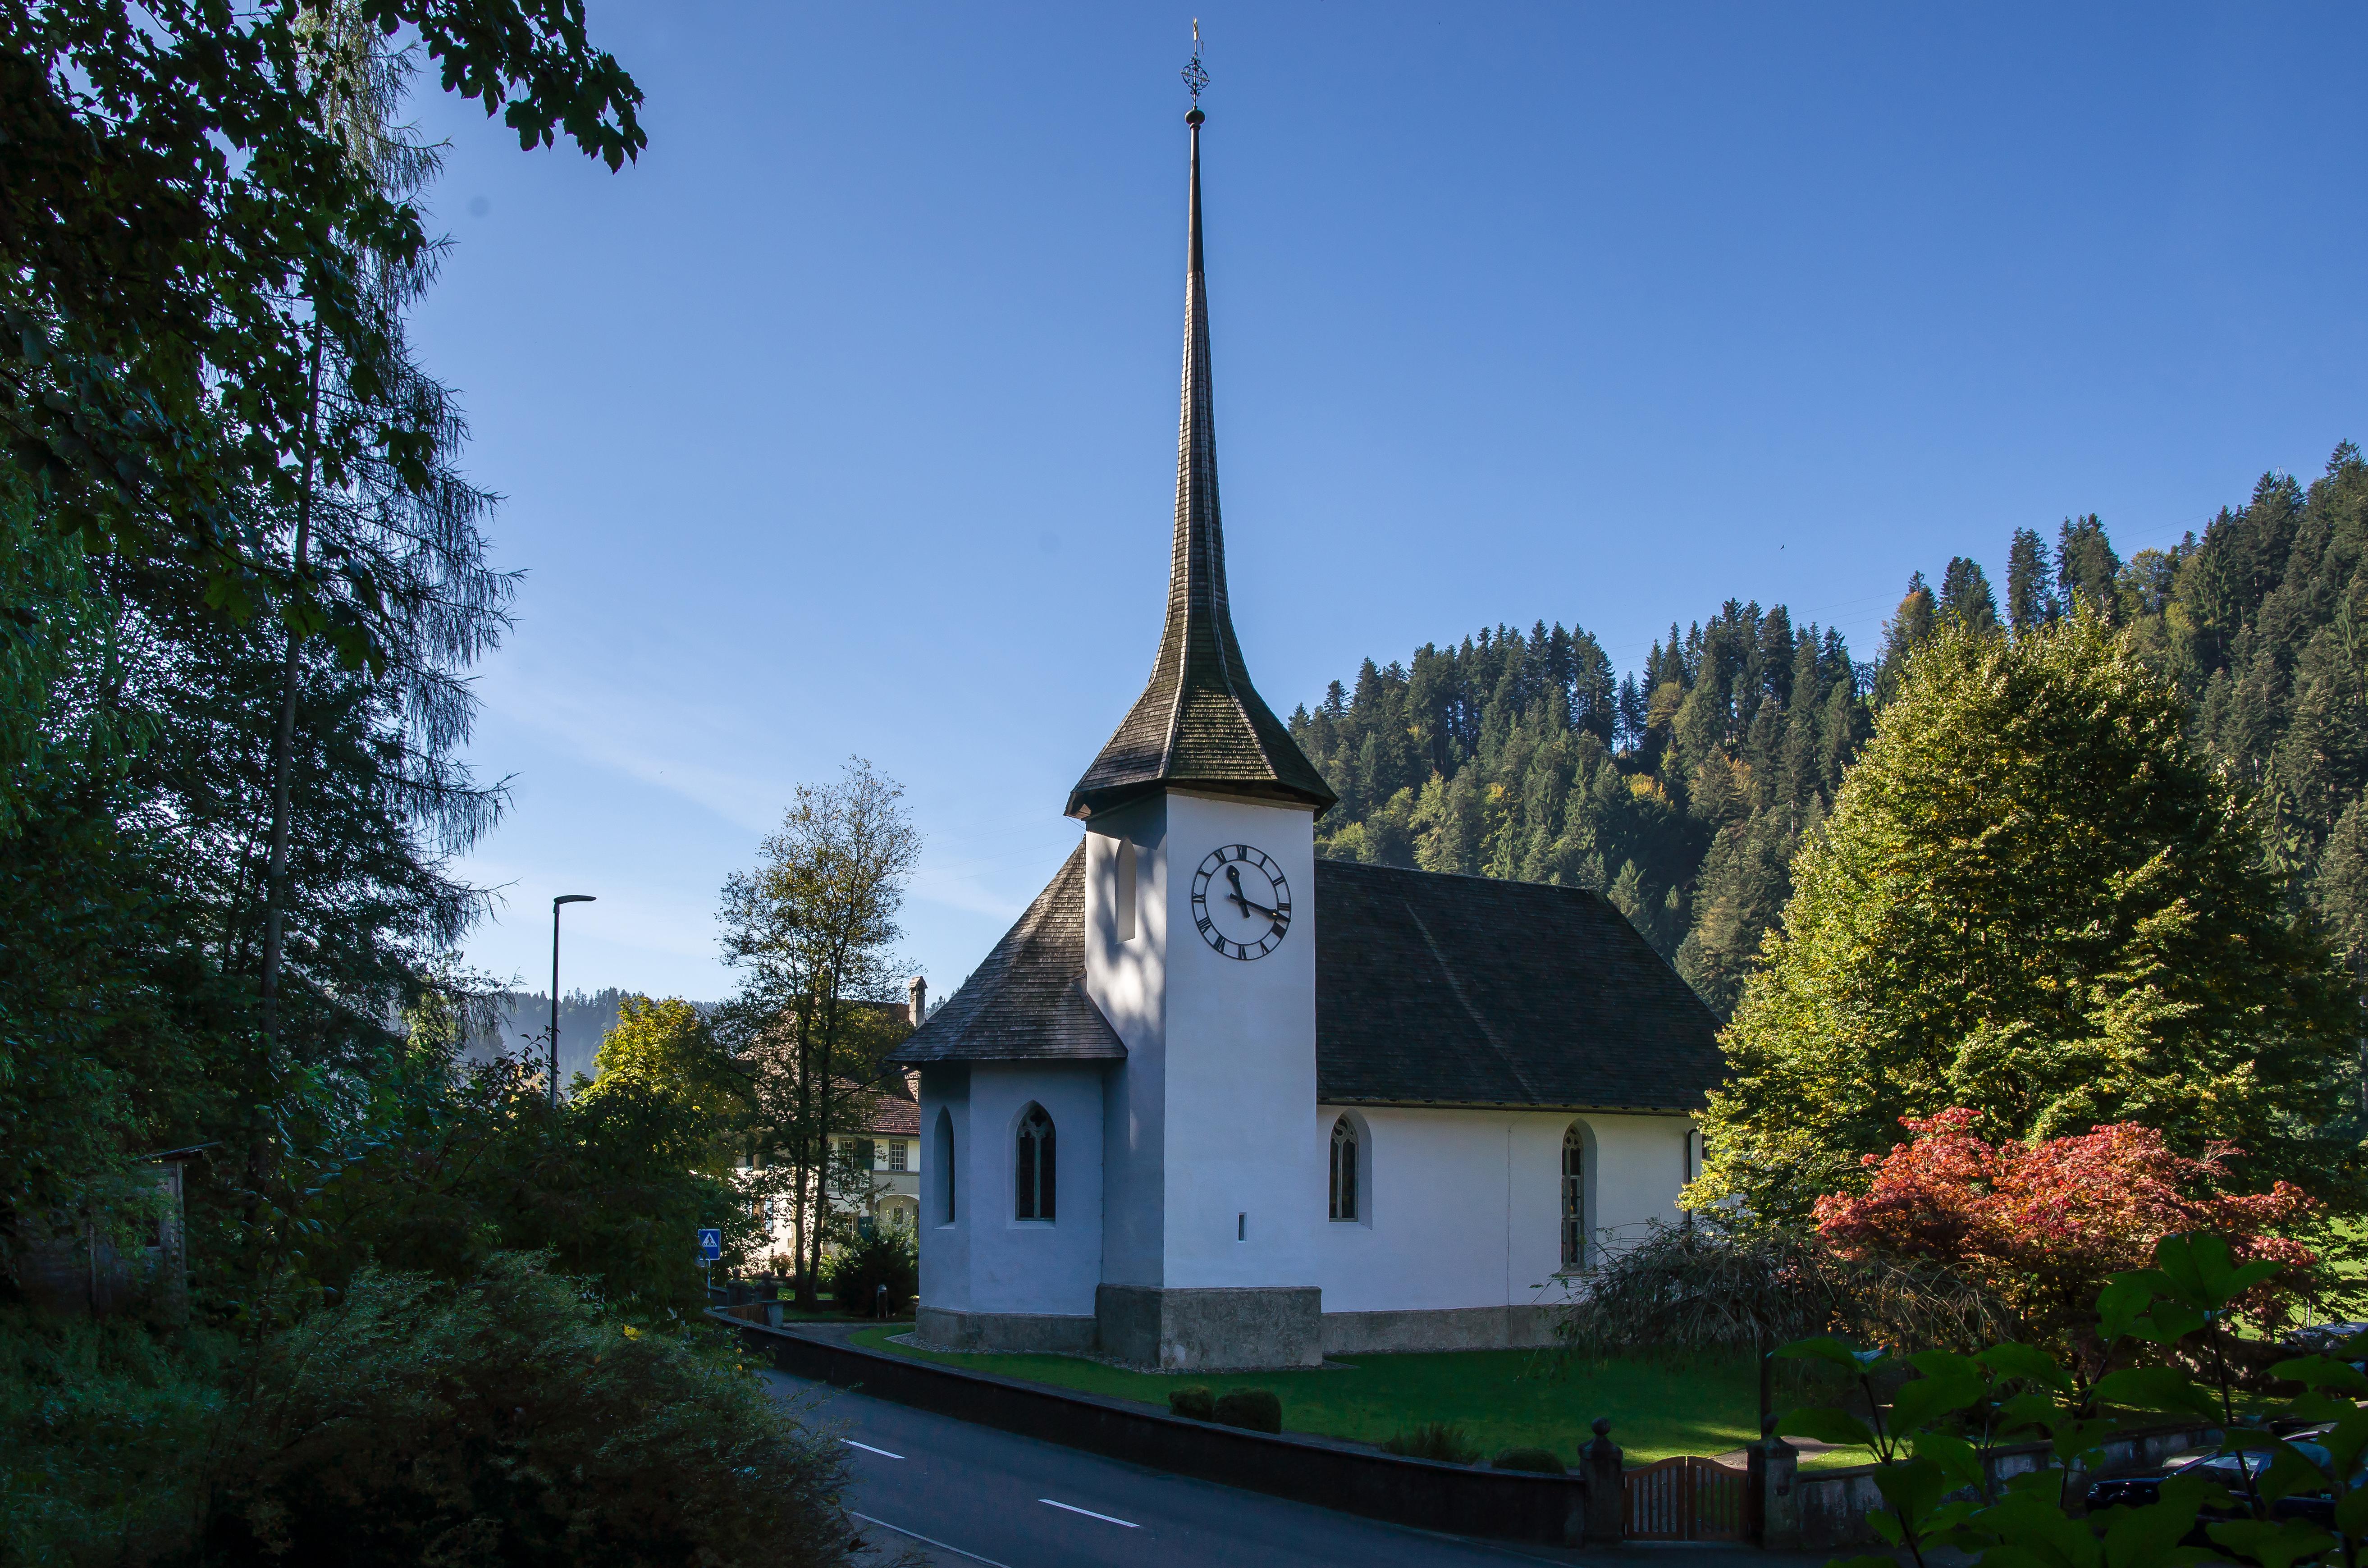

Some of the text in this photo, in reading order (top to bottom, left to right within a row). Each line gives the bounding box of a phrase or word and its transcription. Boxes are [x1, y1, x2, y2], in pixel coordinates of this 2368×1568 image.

[1213, 848, 1227, 865] XI
[1260, 855, 1267, 868] I
[1198, 867, 1212, 880] X
[1272, 876, 1285, 887] II
[1193, 892, 1205, 903] IX
[1278, 902, 1290, 911] III
[1197, 916, 1211, 933] VIII
[1214, 935, 1226, 954] VII
[1259, 941, 1270, 955] V
[1238, 945, 1247, 959] VI
